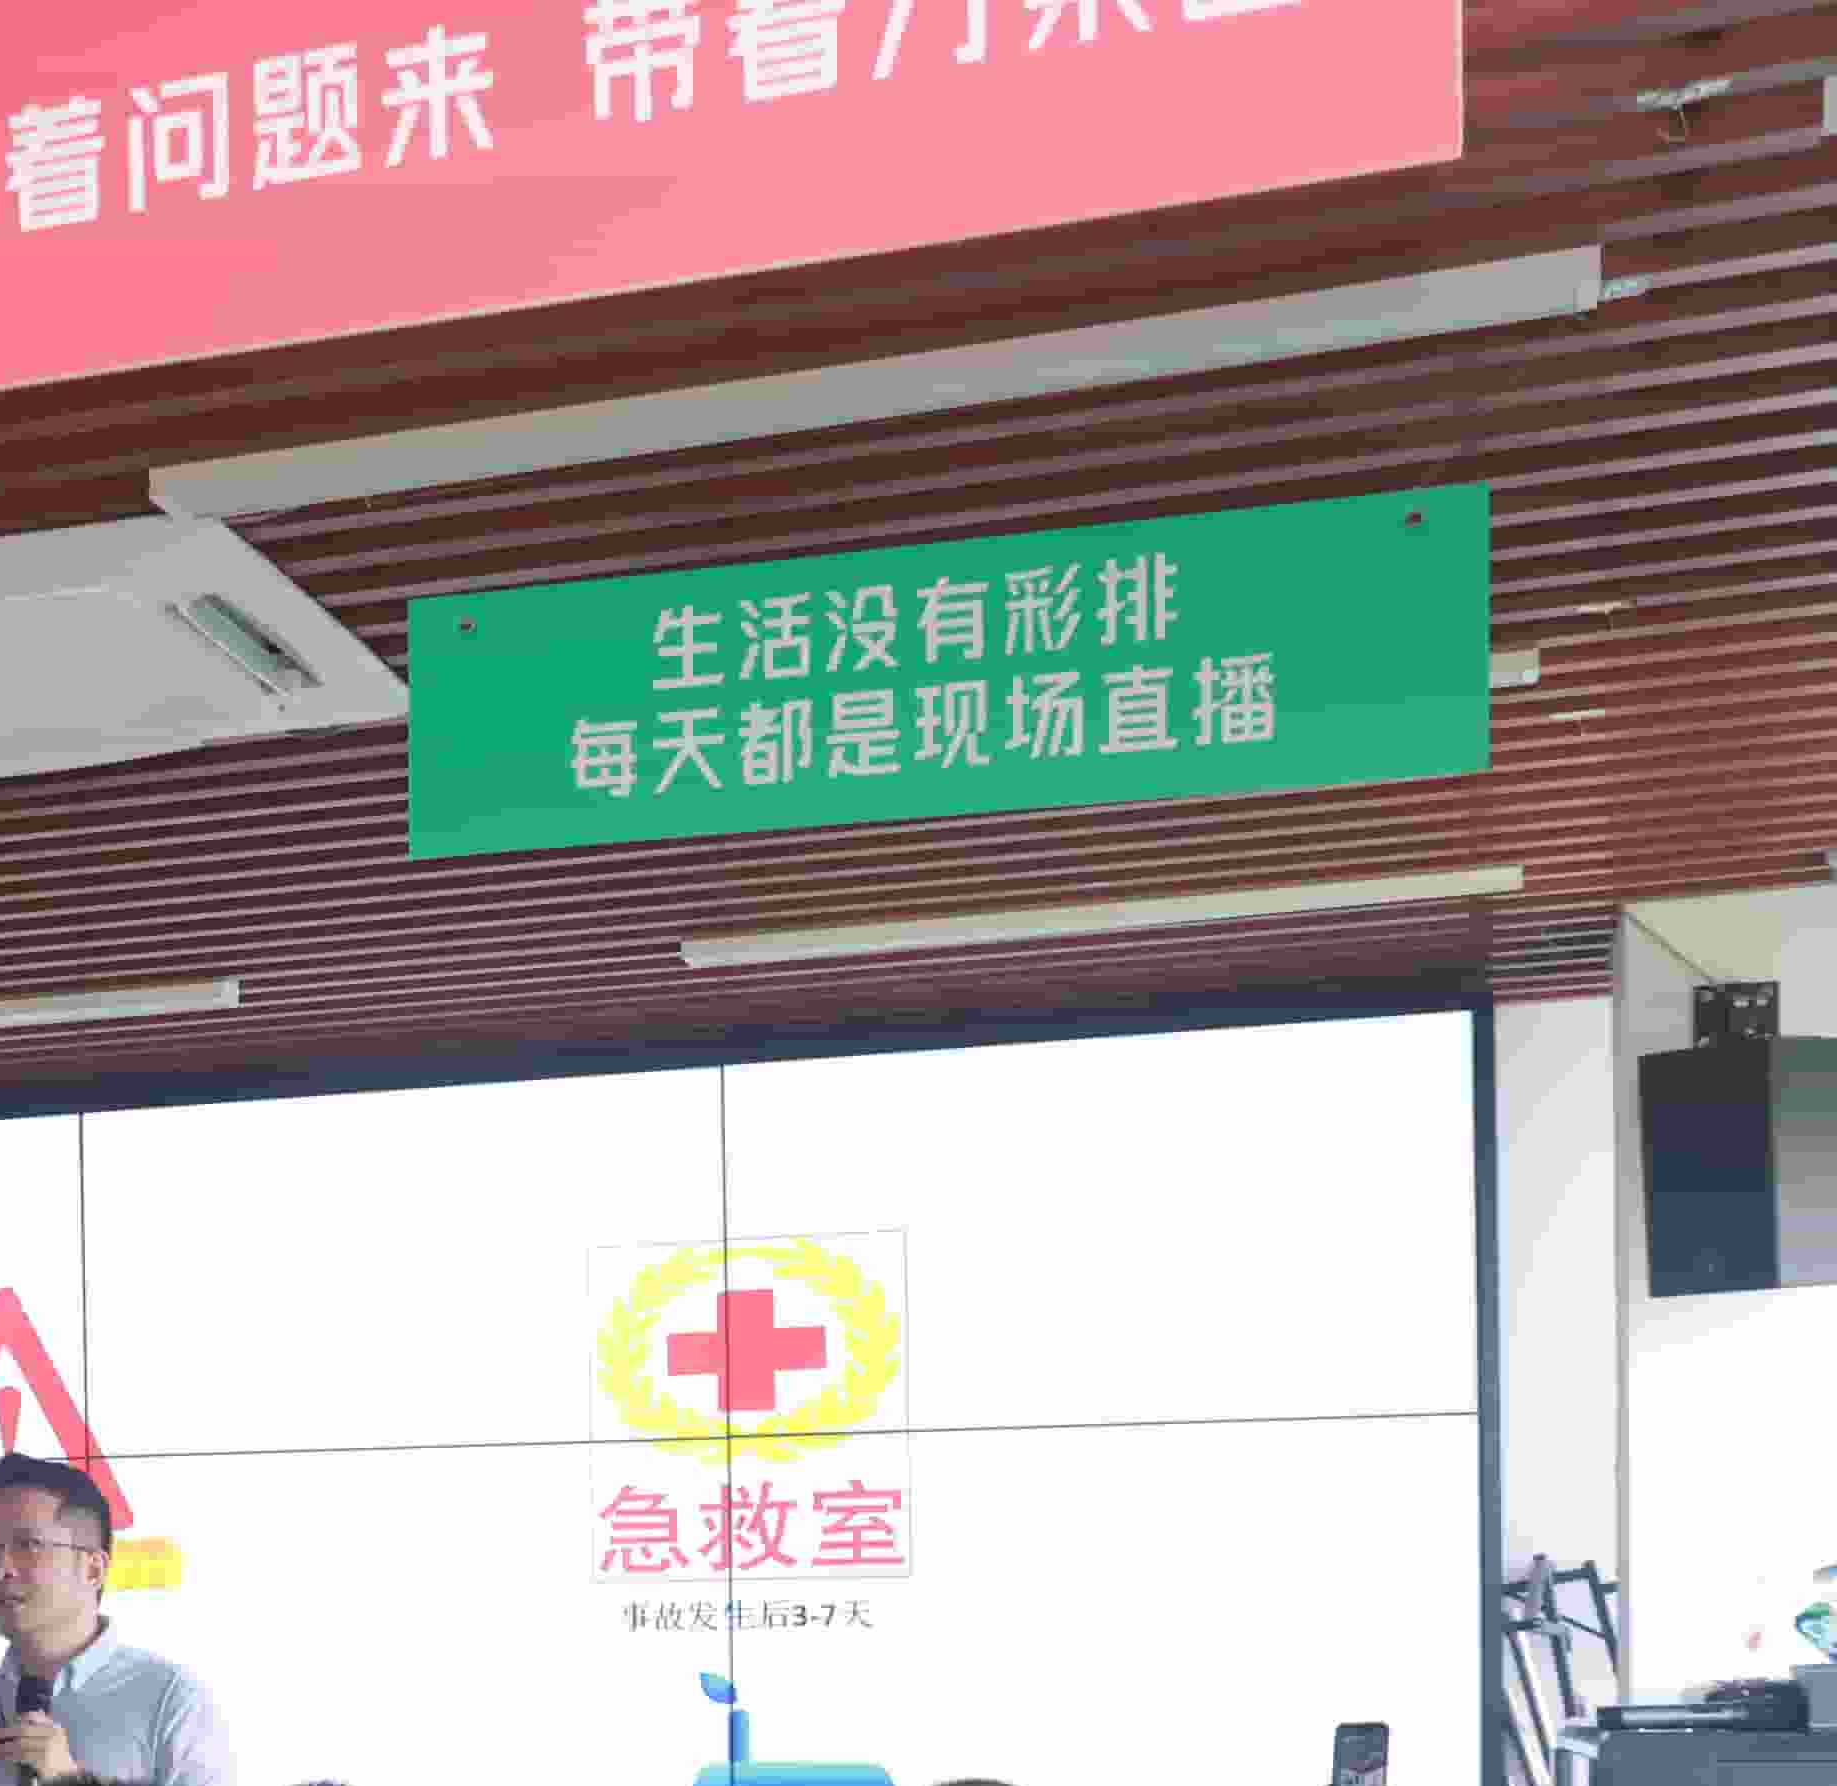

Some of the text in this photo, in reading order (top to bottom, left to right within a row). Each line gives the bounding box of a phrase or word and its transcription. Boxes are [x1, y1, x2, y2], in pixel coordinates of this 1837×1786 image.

[652, 551, 1179, 692] 生活没有彩排
[569, 650, 1278, 798] 每天都是现场直播
[598, 1479, 906, 1573] 急救室
[622, 1600, 875, 1632] 事故发生后3-7天
